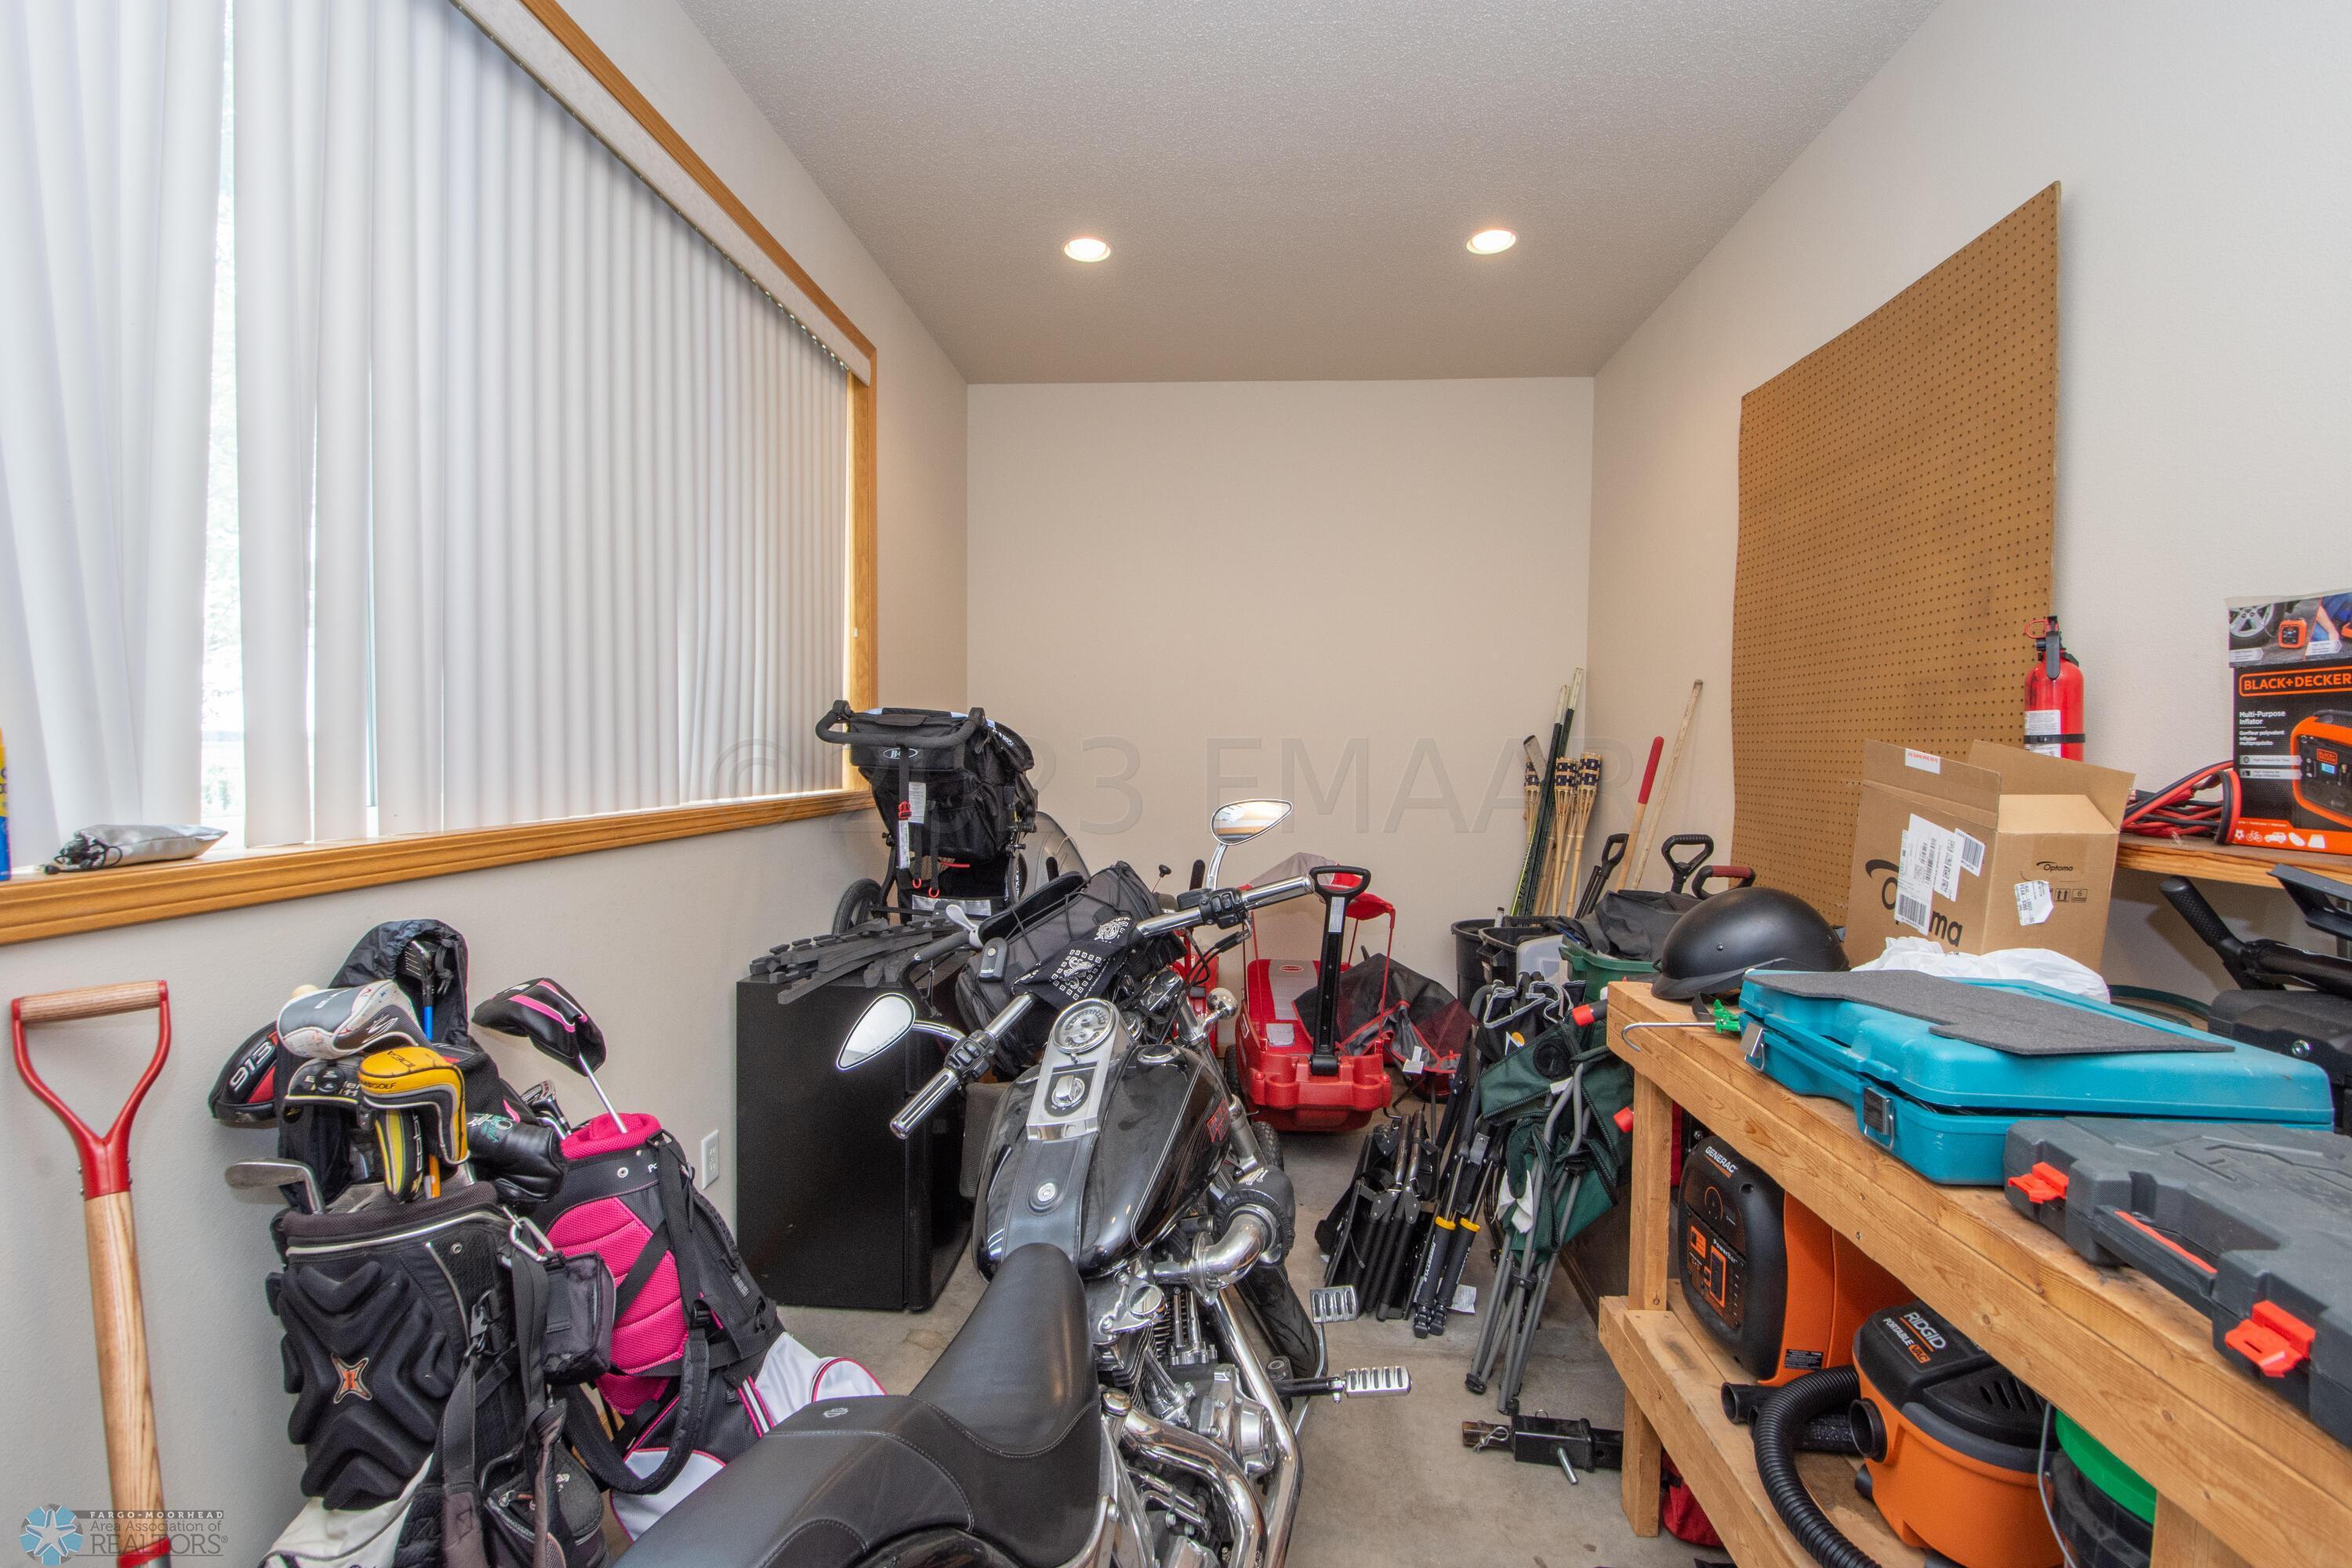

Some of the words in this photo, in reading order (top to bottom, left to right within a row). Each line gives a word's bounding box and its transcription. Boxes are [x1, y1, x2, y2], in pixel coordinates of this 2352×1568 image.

[2243, 673, 2352, 691] BLACK+DECKER
[2043, 863, 2074, 872] Optoma
[230, 1041, 273, 1092] 913
[1705, 1145, 1736, 1174] GENERAC
[1882, 1317, 1915, 1346] PORTABLE
[1911, 1344, 1928, 1362] VAC
[1904, 1312, 1947, 1348] RIDGID
